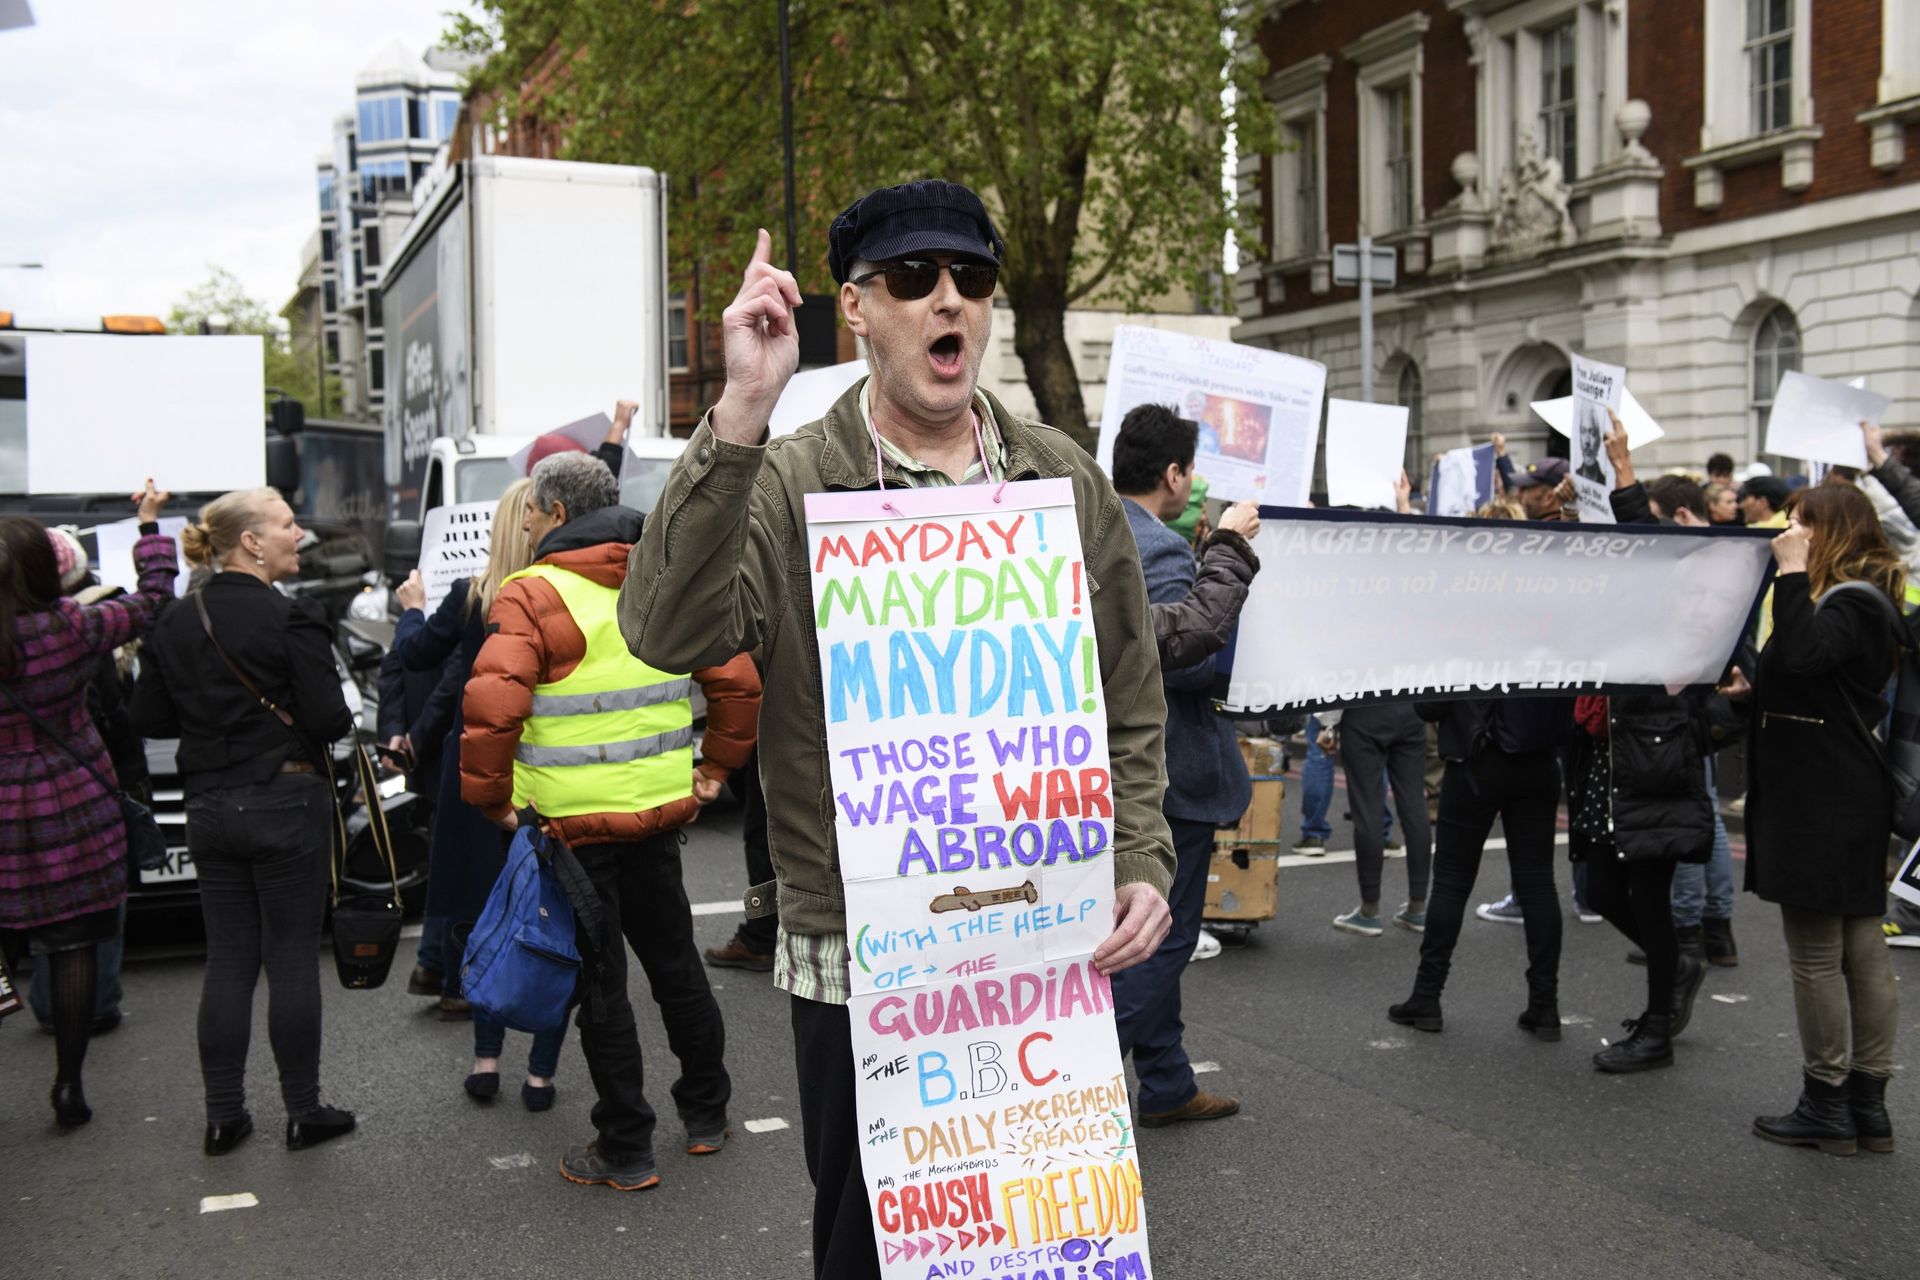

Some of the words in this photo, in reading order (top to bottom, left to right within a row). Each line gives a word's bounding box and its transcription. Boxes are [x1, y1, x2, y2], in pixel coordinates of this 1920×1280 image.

[1589, 369, 1613, 387] Julian
[816, 555, 1082, 629] MAYDAY!
[830, 619, 1097, 723] MAYDAY!
[839, 731, 976, 781] THOSE
[986, 724, 1093, 766] WHO
[837, 772, 979, 827] WAGE
[992, 767, 1114, 821] WAR
[897, 818, 1108, 877] ABROAD
[947, 911, 1005, 942] THE
[1013, 898, 1097, 938] HELP
[874, 964, 916, 989] OF
[945, 953, 997, 977] THE
[862, 1053, 878, 1070] AND
[866, 1054, 910, 1081] THE
[917, 1031, 1071, 1108] B.B.C.
[1004, 1073, 1127, 1126] EXCREMENT
[867, 1127, 899, 1147] THE
[869, 1117, 886, 1135] AND
[877, 1176, 895, 1190] AND
[903, 1169, 921, 1182] THE
[877, 1172, 994, 1234] CRUSH
[925, 1259, 976, 1280] AND
[990, 1237, 1114, 1271] DESTROY
